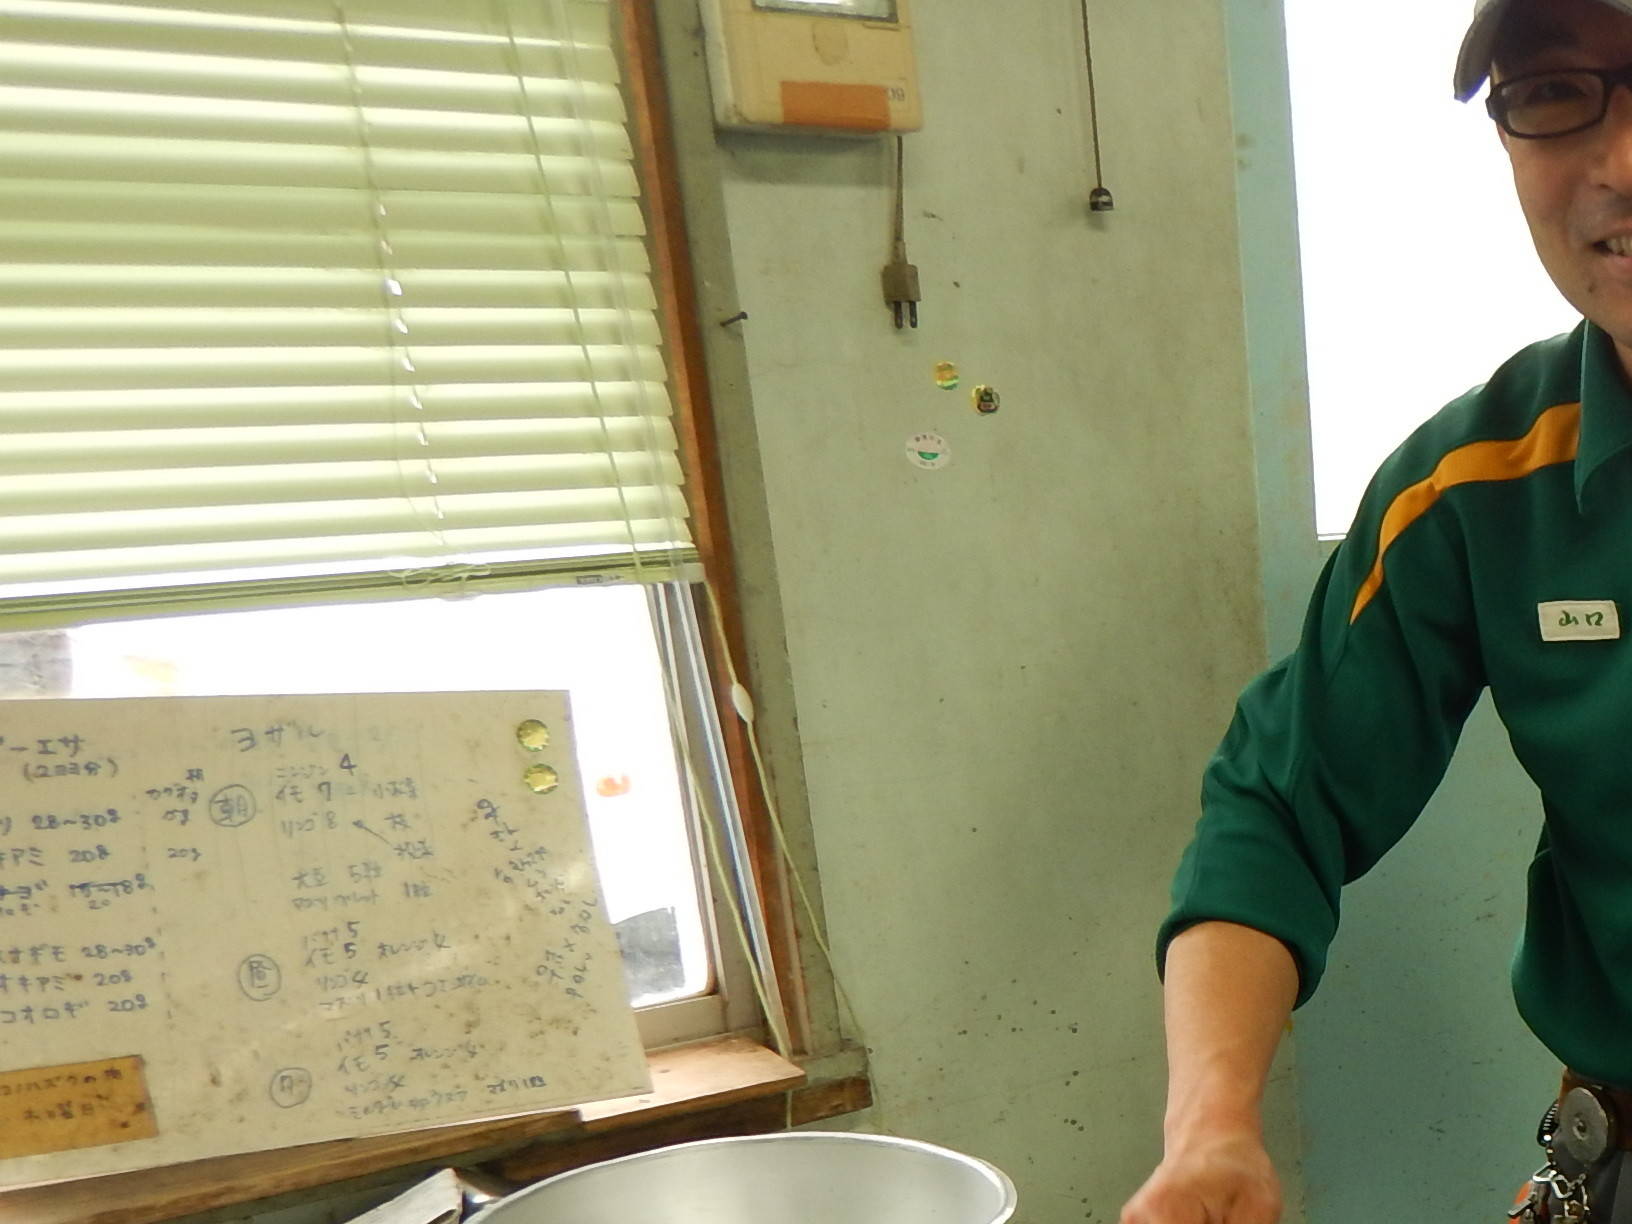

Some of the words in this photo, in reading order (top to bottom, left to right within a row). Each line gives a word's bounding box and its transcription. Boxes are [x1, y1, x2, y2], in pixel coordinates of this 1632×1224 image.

[339, 752, 358, 777] 4
[347, 920, 361, 940] 5
[343, 941, 356, 960] 5
[377, 1019, 392, 1040] 5
[374, 1043, 390, 1061] 5
